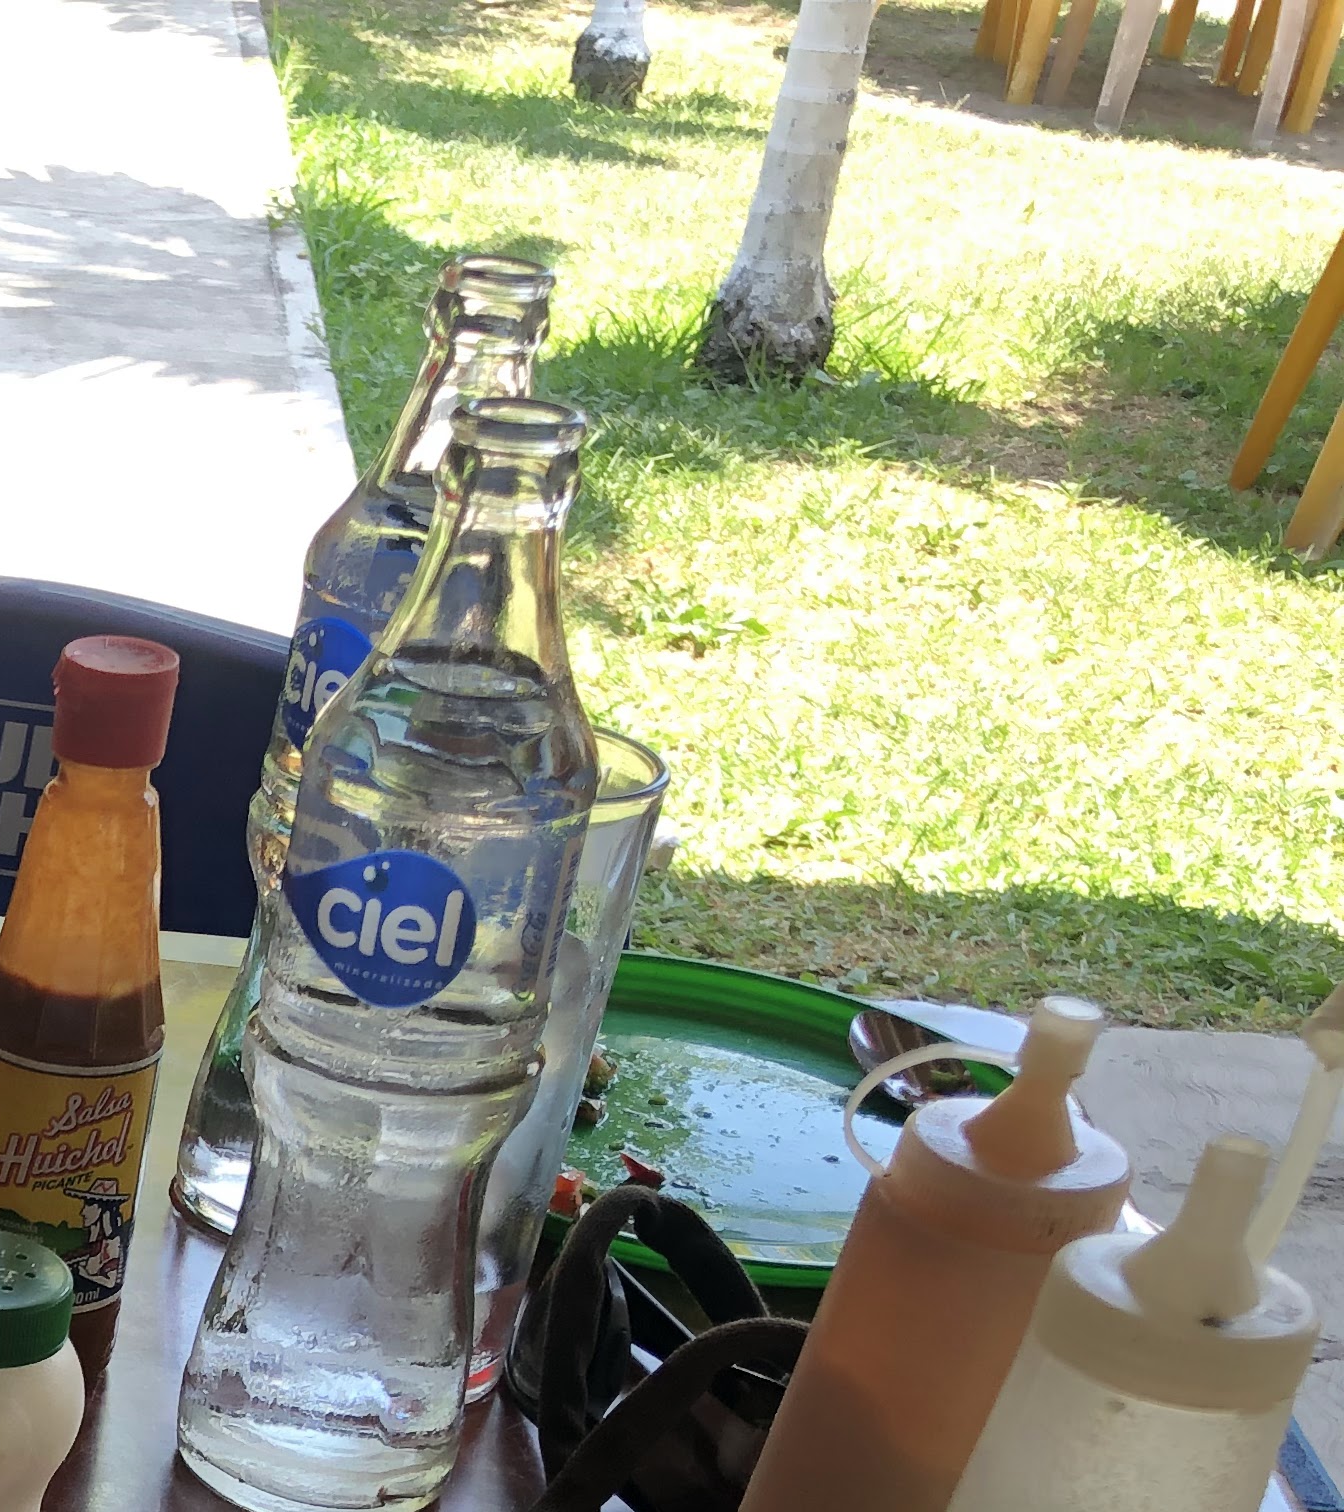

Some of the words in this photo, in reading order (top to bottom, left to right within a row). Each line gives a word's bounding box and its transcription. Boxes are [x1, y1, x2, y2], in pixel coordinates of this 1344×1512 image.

[285, 649, 349, 716] cie
[318, 887, 464, 967] ciel
[43, 1086, 132, 1137] Salsa
[31, 1170, 94, 1191] PICANTE
